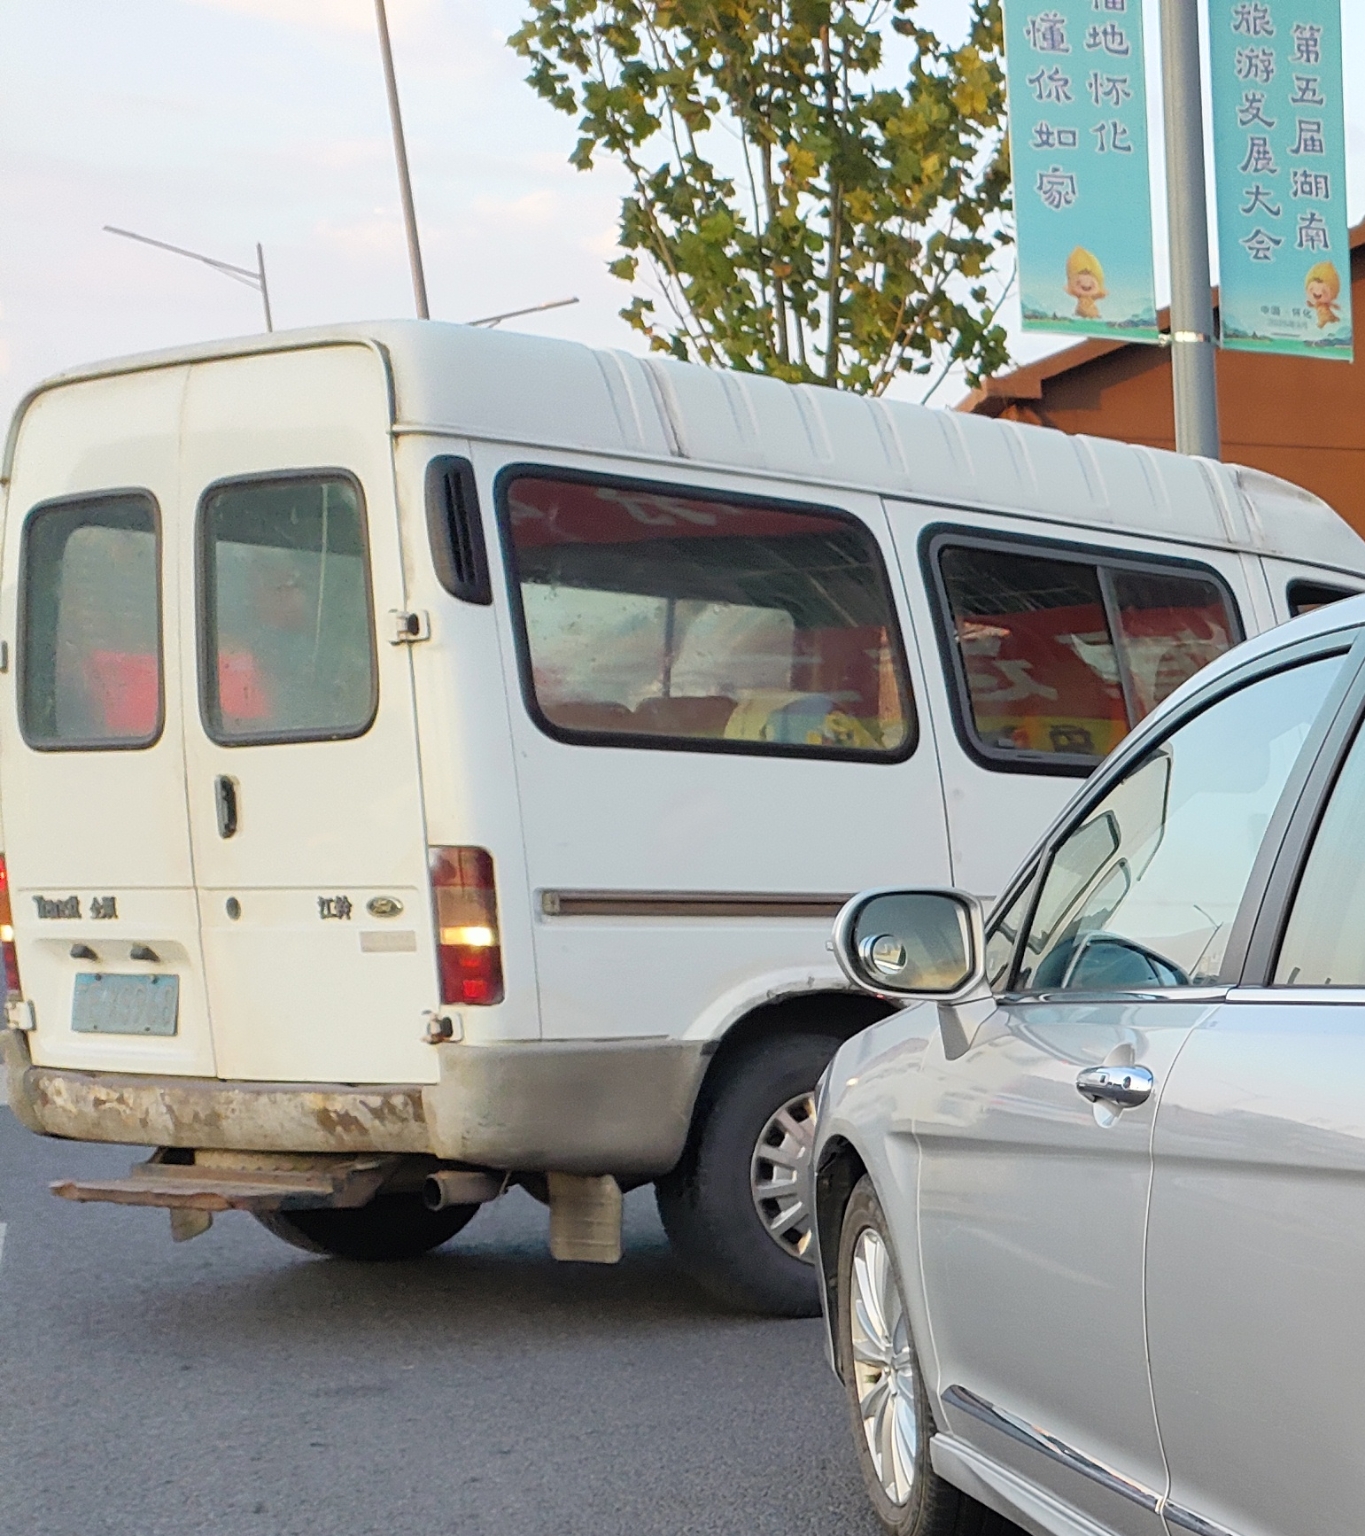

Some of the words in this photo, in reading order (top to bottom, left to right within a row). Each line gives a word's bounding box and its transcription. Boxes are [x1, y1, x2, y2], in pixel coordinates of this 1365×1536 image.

[1025, 12, 1077, 209] 懂你如家
[1232, 3, 1282, 261] 旅游发展大会
[1289, 24, 1329, 250] 第五届湖南
